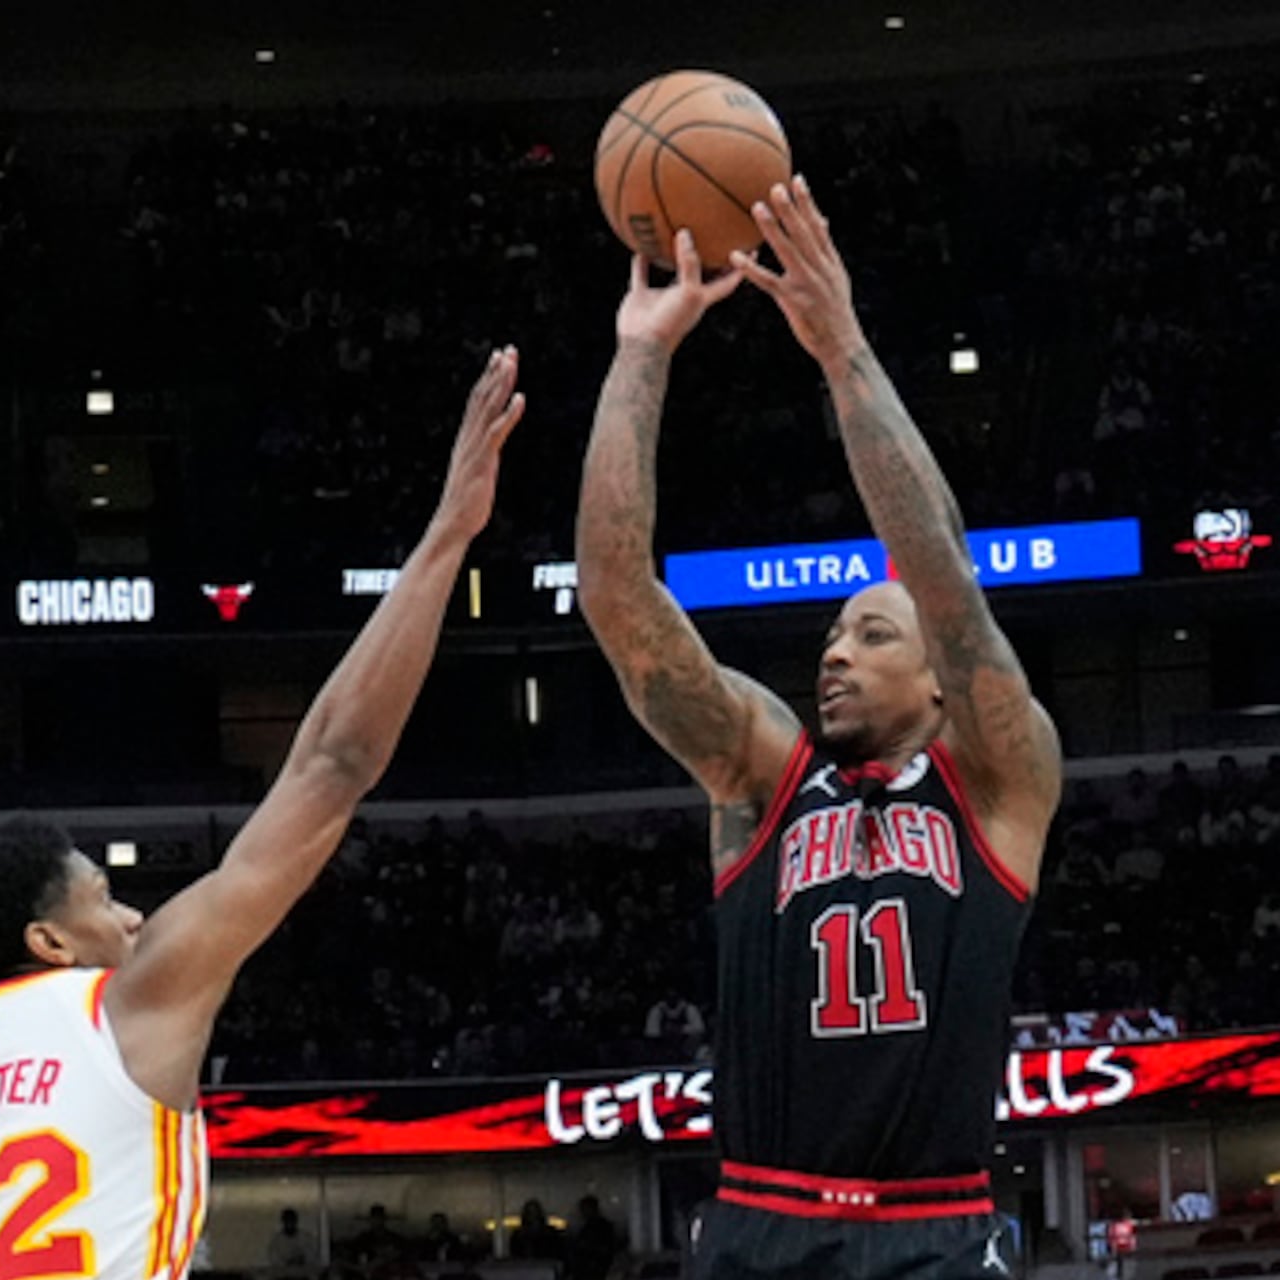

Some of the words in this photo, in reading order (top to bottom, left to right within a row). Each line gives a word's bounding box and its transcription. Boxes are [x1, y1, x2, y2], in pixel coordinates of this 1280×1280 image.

[745, 552, 871, 591] ULTRA
[18, 579, 154, 625] CHICAGO
[811, 899, 927, 1038] 11
